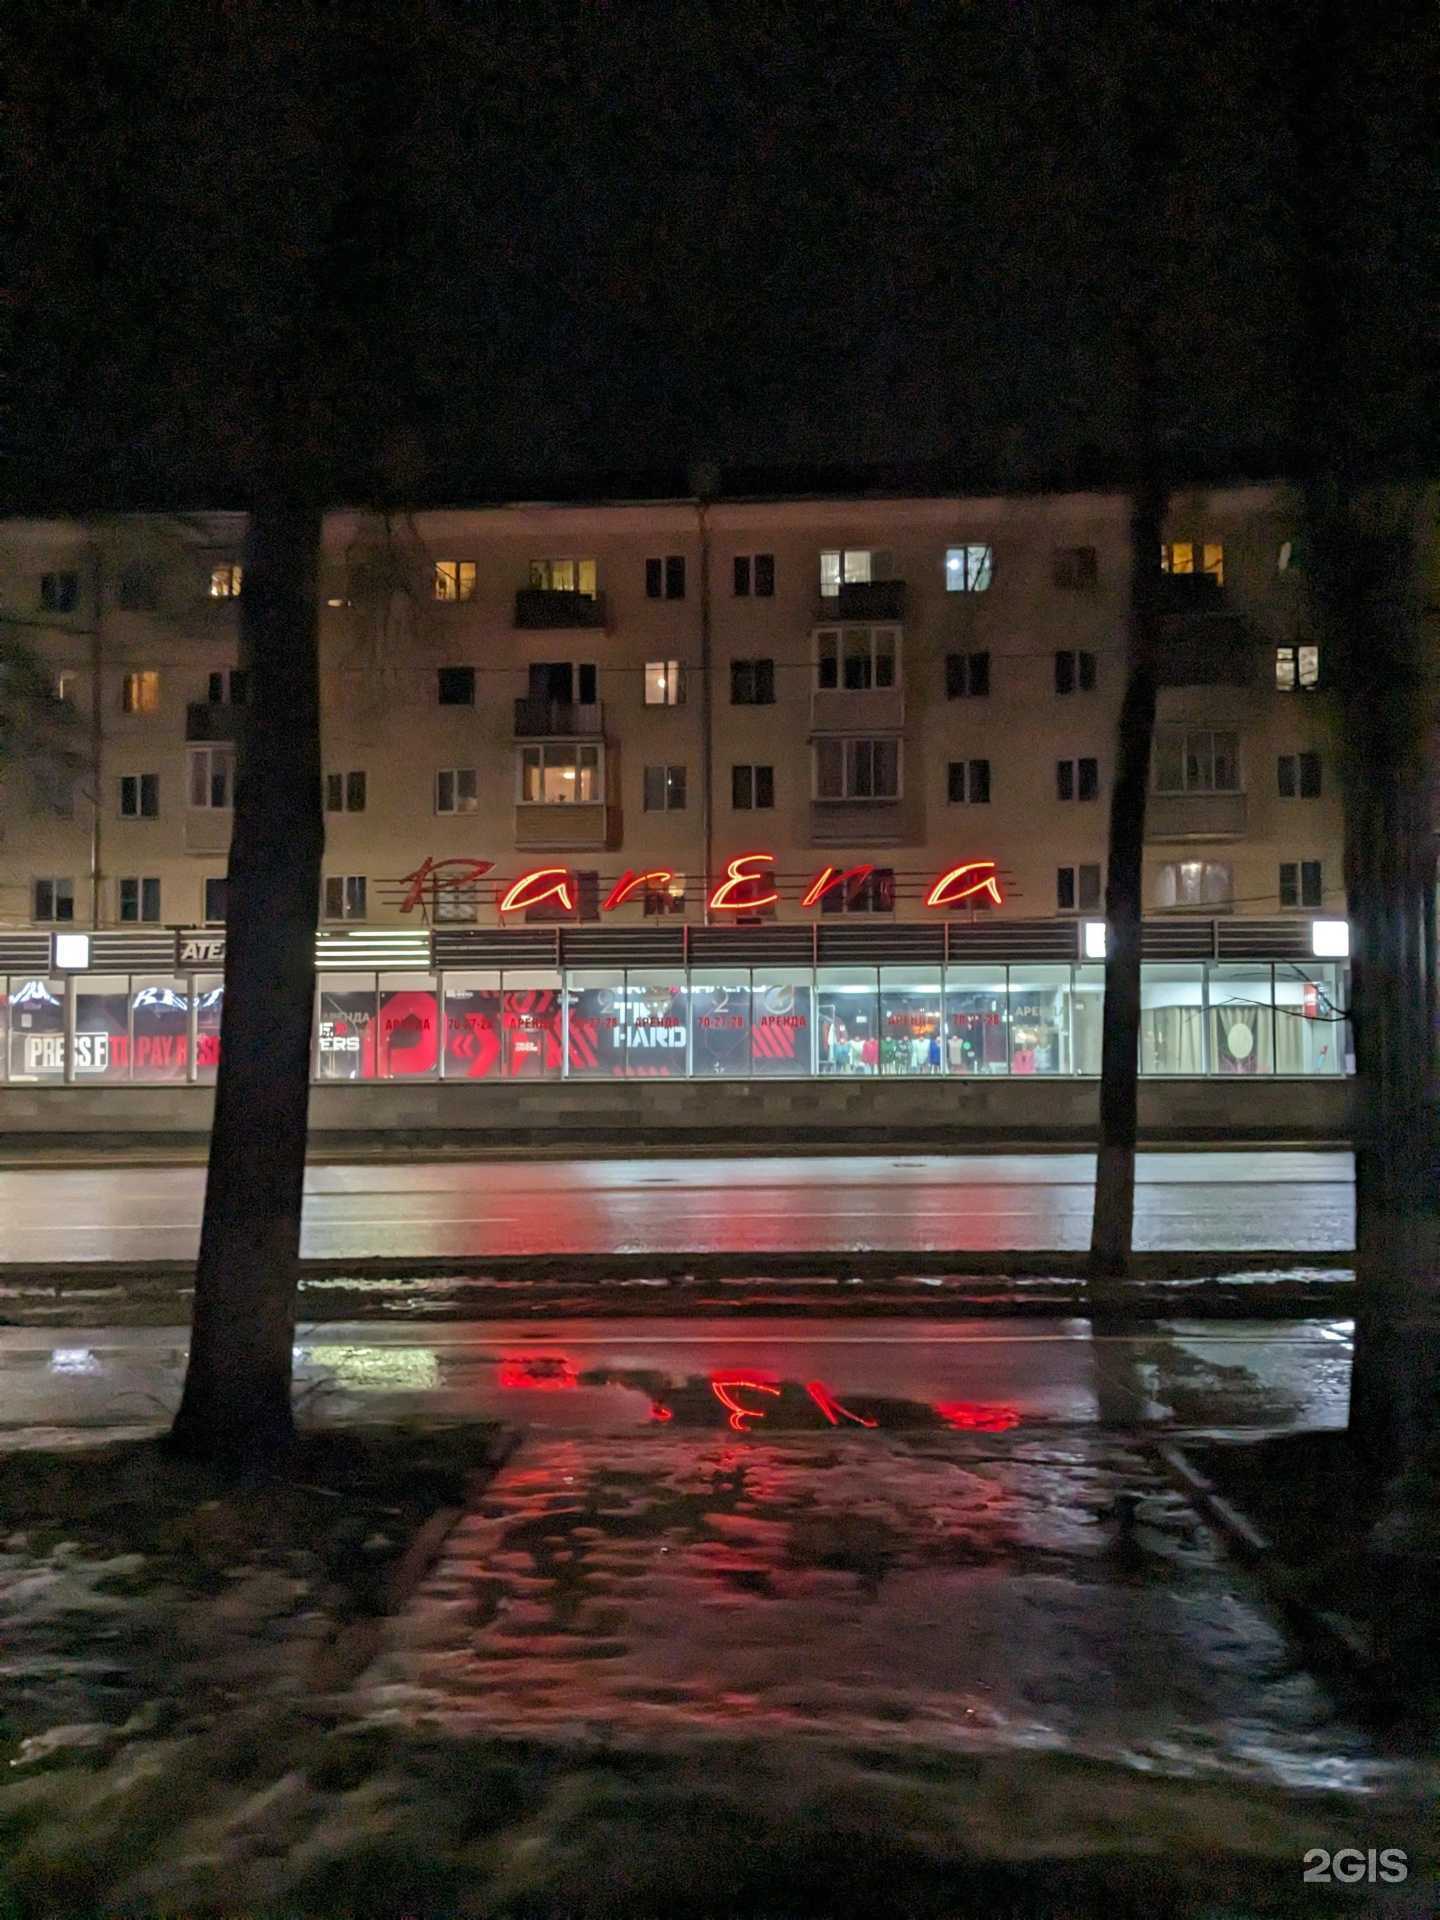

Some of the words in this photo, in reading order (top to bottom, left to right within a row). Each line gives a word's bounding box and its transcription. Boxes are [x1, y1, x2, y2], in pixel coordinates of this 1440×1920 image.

[180, 942, 226, 960] АТЕ
[761, 1015, 807, 1030] АРЕНДА
[613, 1026, 687, 1048] HARD
